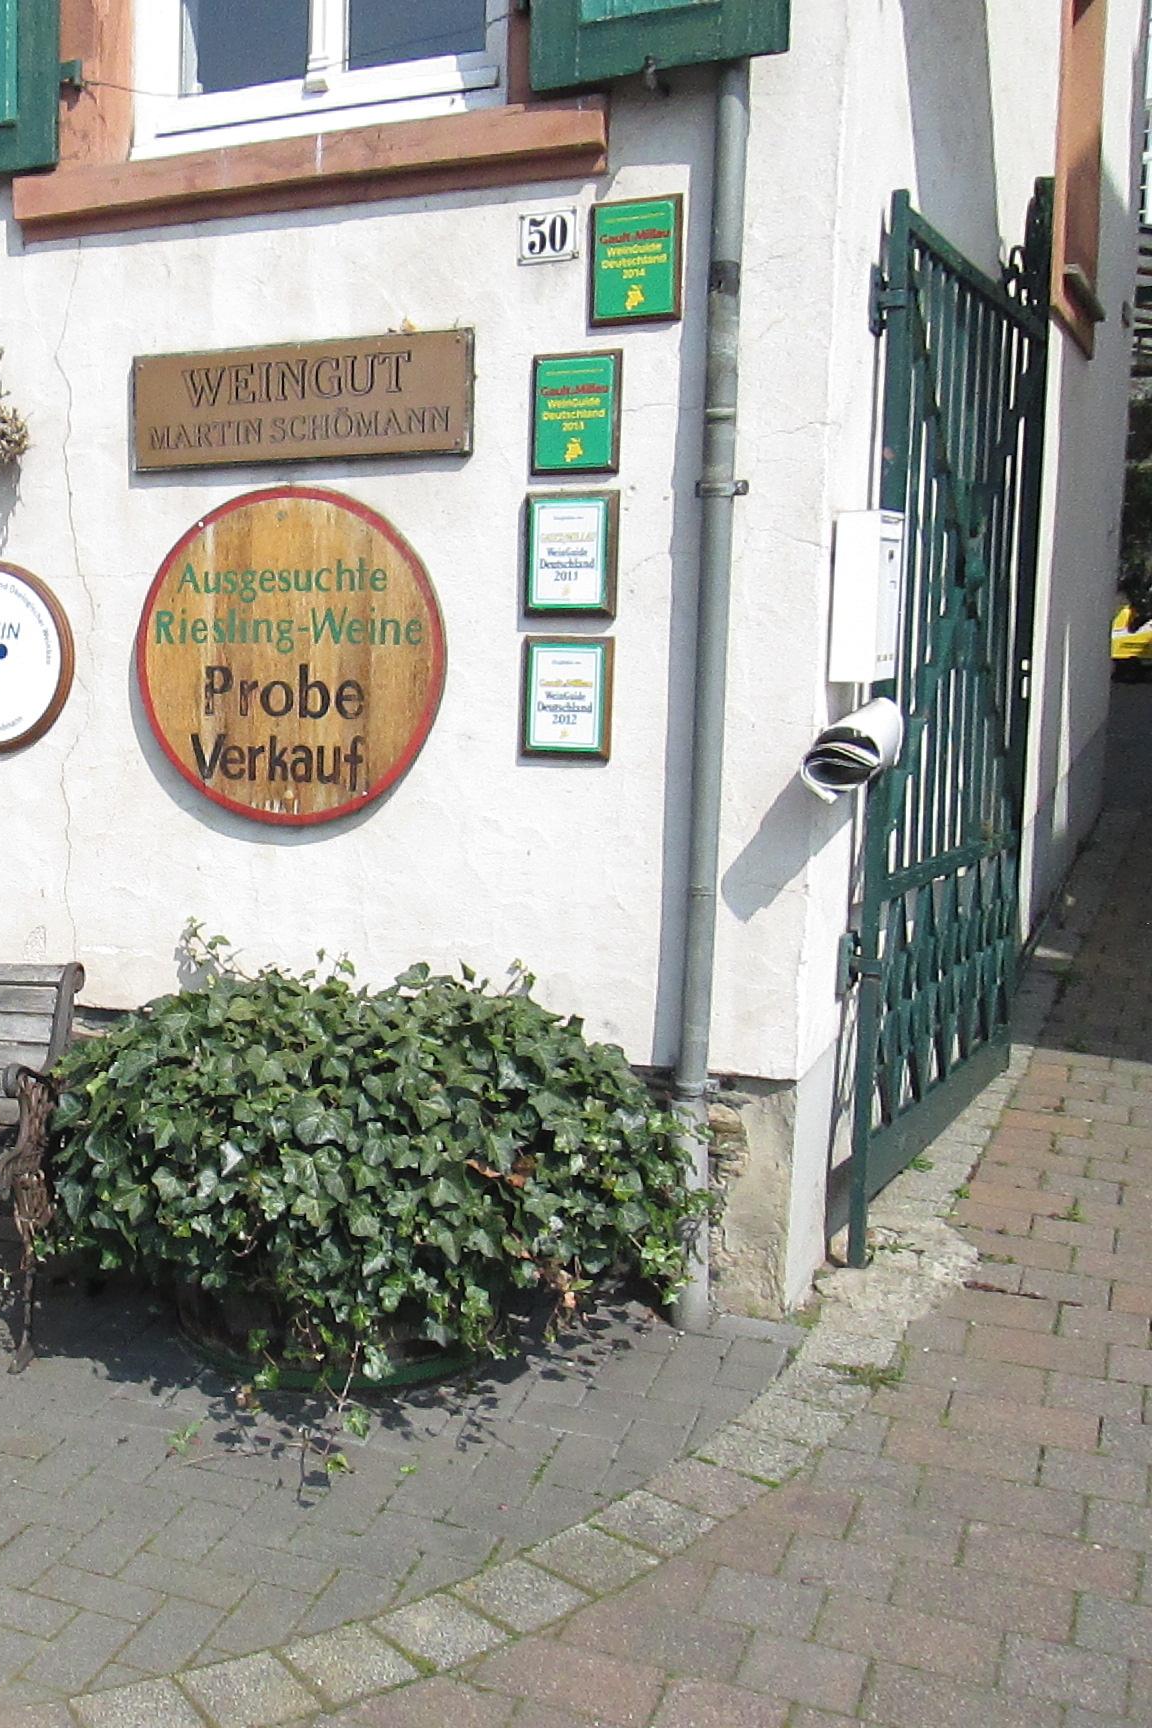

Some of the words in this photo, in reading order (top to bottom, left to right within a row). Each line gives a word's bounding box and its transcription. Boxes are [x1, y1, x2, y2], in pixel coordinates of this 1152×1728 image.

[528, 214, 568, 255] 50
[181, 351, 412, 408] WEINGUT
[149, 418, 263, 450] MARTIN
[270, 406, 451, 444] SCHÖMANN
[177, 557, 388, 603] Ausgesuchte
[539, 558, 595, 569] Deutschland
[554, 570, 578, 581] 2011
[154, 606, 425, 654] Riesling-Weine
[203, 663, 365, 720] Probe
[537, 702, 593, 712] Deutschland
[552, 714, 577, 725] 2012
[190, 733, 367, 792] Verkauf
